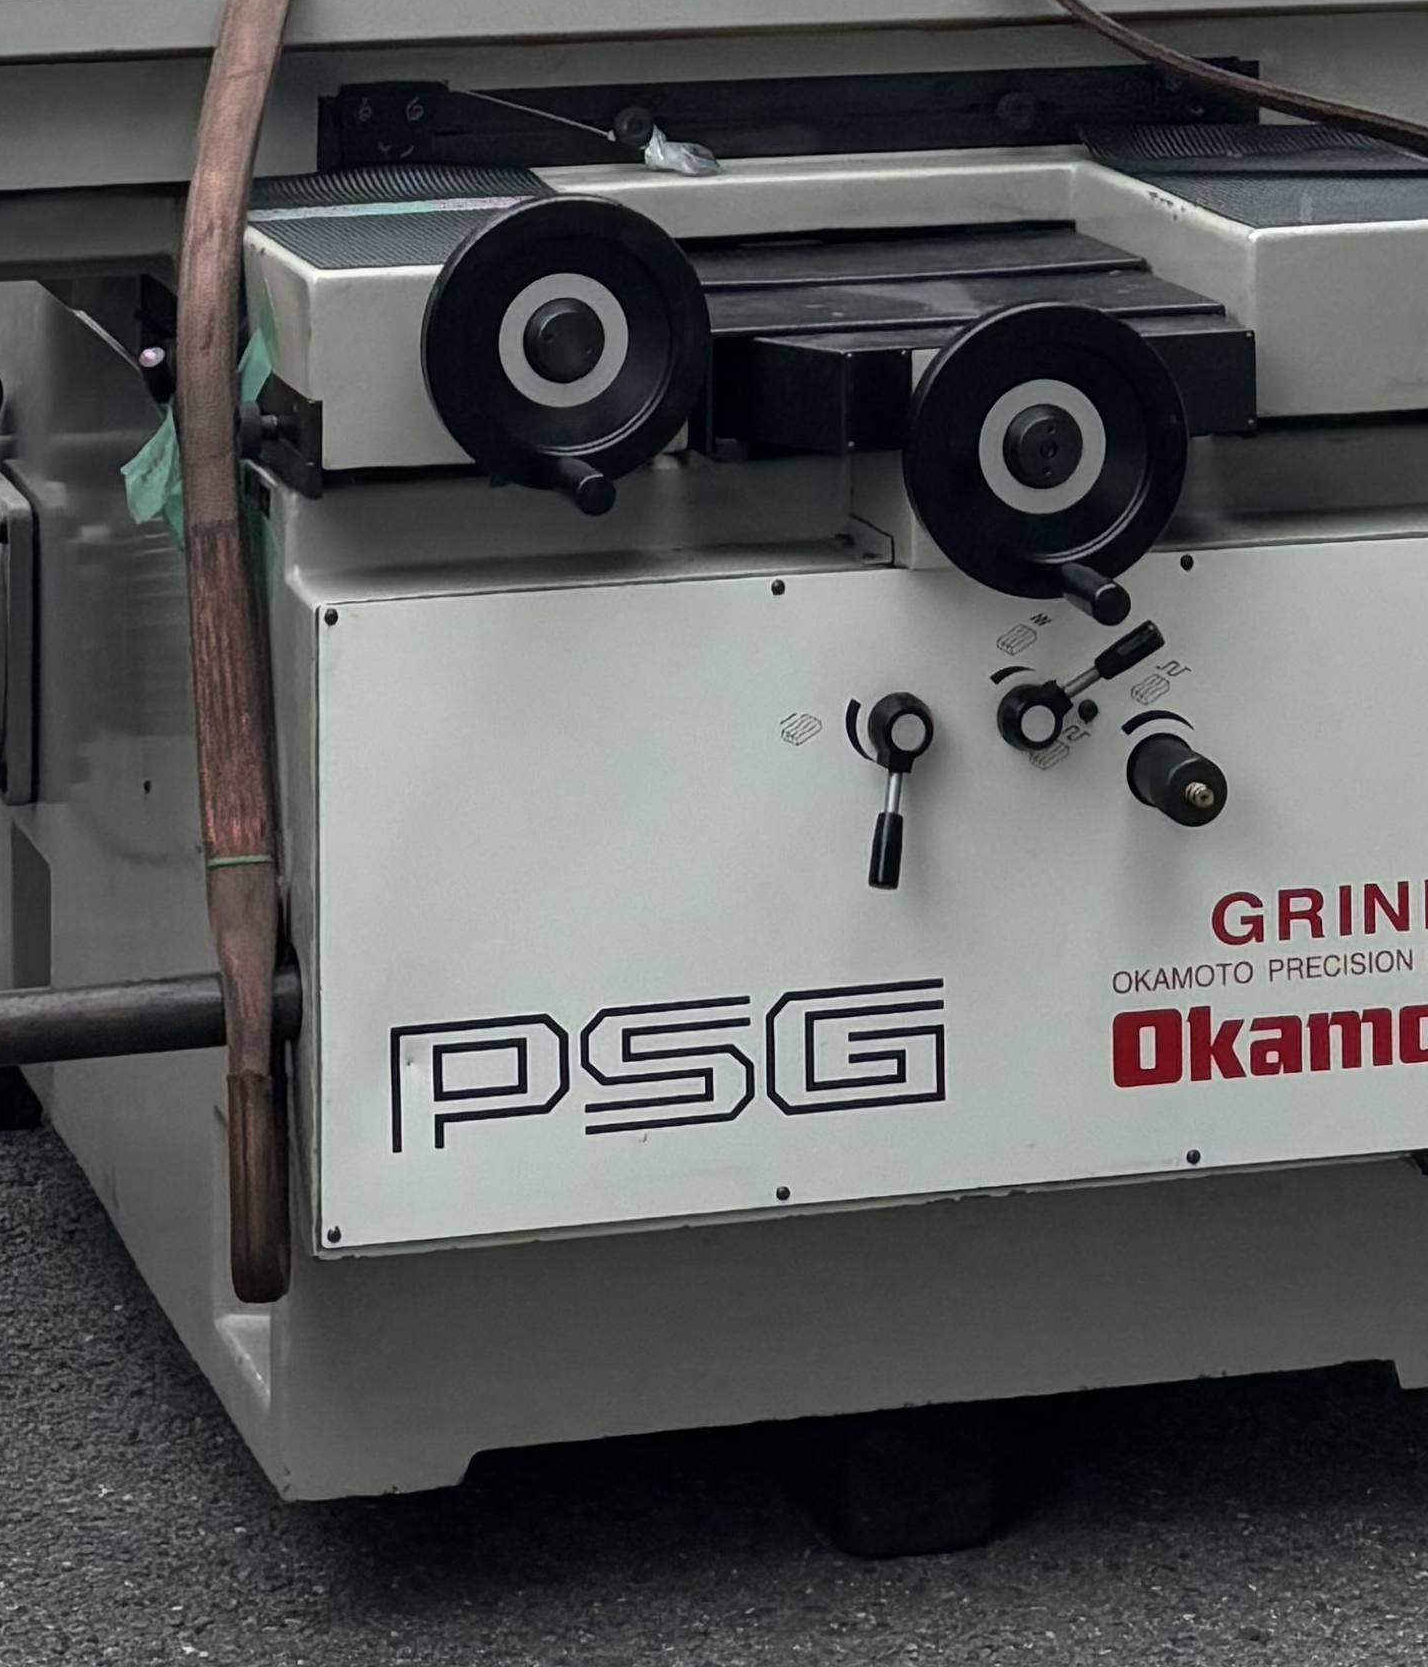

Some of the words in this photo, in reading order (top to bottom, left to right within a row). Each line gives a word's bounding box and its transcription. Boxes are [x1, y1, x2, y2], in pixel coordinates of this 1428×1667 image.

[1112, 961, 1254, 995] OKAMOTO
[1269, 948, 1414, 983] PRECISION
[390, 978, 946, 1153] PSG
